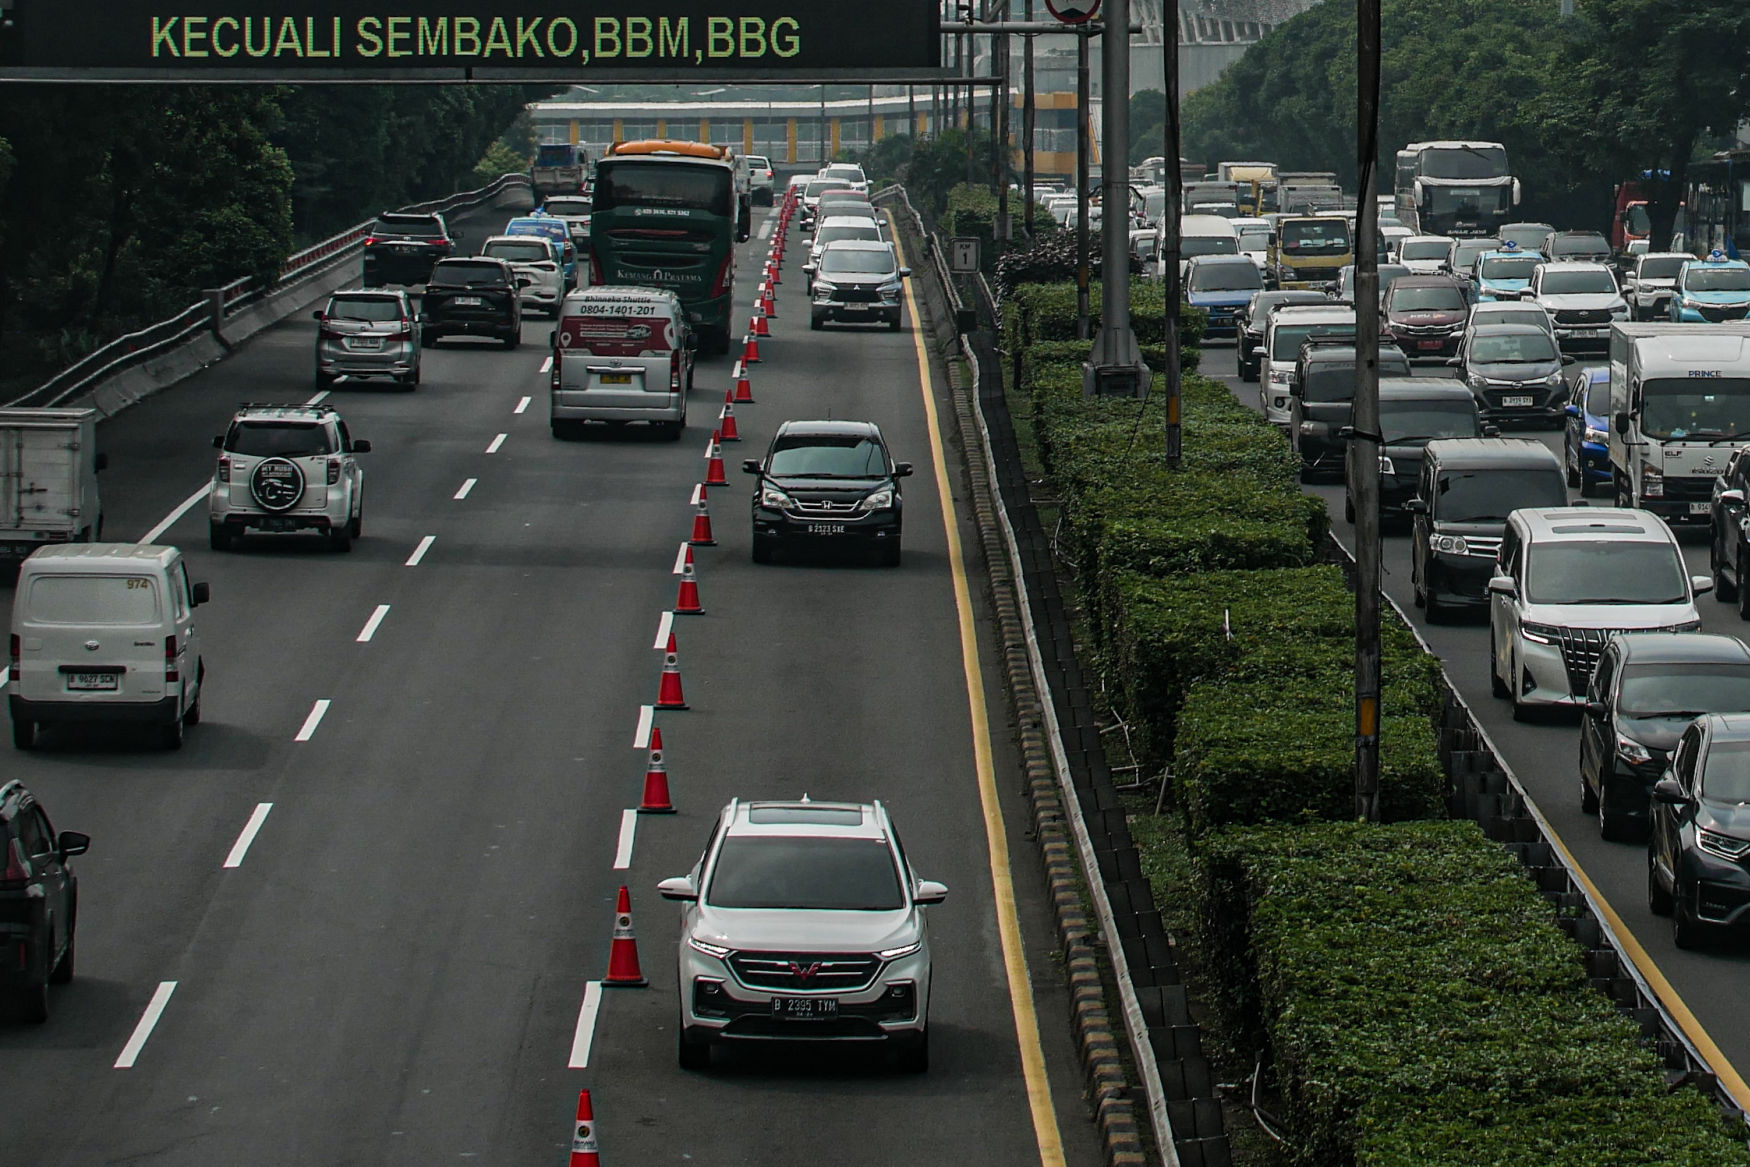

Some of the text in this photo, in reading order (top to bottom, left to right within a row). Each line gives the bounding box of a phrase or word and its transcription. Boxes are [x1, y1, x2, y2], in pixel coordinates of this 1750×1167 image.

[152, 16, 341, 57] KECUALI
[963, 253, 968, 265] 1
[580, 305, 655, 315] 0804-1401-201
[127, 578, 149, 590] 974
[774, 998, 836, 1012] B 2395 TYM
